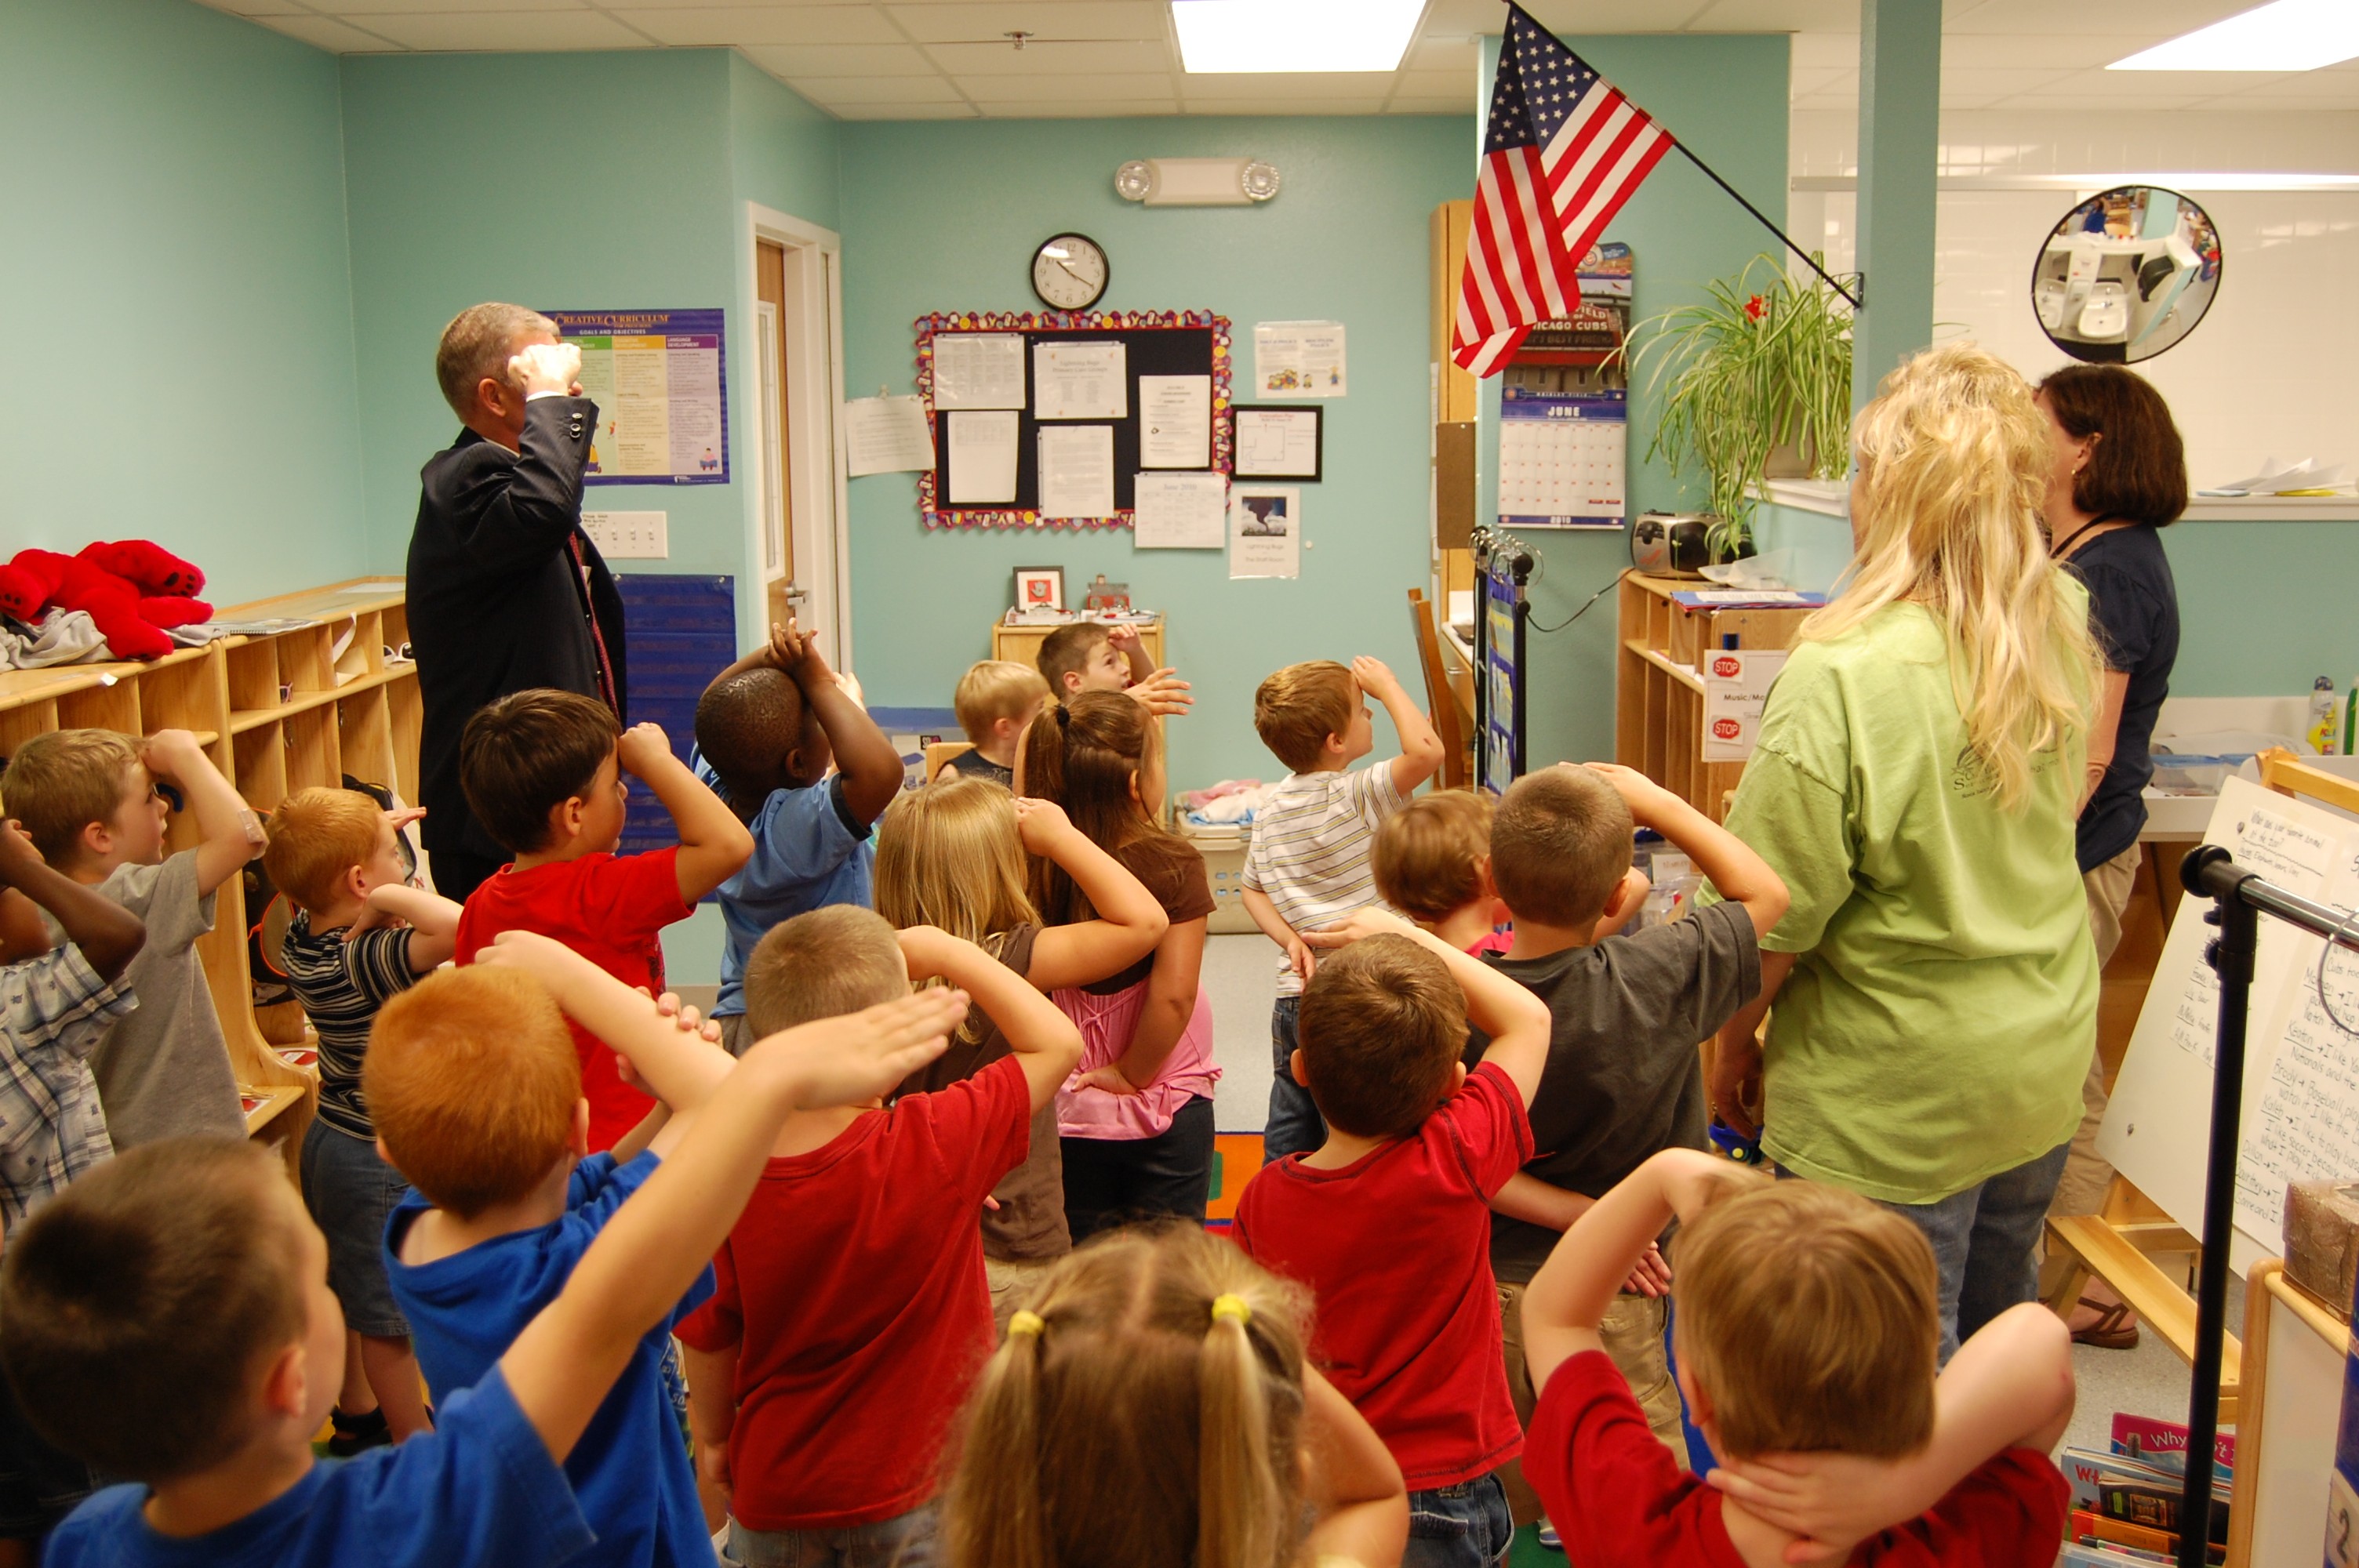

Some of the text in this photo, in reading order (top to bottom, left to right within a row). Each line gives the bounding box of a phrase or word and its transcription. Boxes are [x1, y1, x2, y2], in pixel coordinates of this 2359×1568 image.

[1067, 242, 1075, 252] 12
[1082, 245, 1086, 255] 1
[1090, 255, 1096, 264] 2
[1040, 267, 1046, 277] 9
[1054, 289, 1060, 299] 7
[1067, 294, 1072, 303] 6
[1081, 291, 1087, 299] 5
[555, 314, 668, 326] CREATIVE CURRICULUM
[1532, 321, 1608, 330] ICAGO CUBS
[1547, 406, 1580, 417] JUNE
[1715, 662, 1738, 673] STOP
[1715, 724, 1738, 734] STOP
[2325, 1067, 2343, 1082] and
[2325, 1142, 2343, 1164] play
[2150, 1430, 2186, 1449] Why
